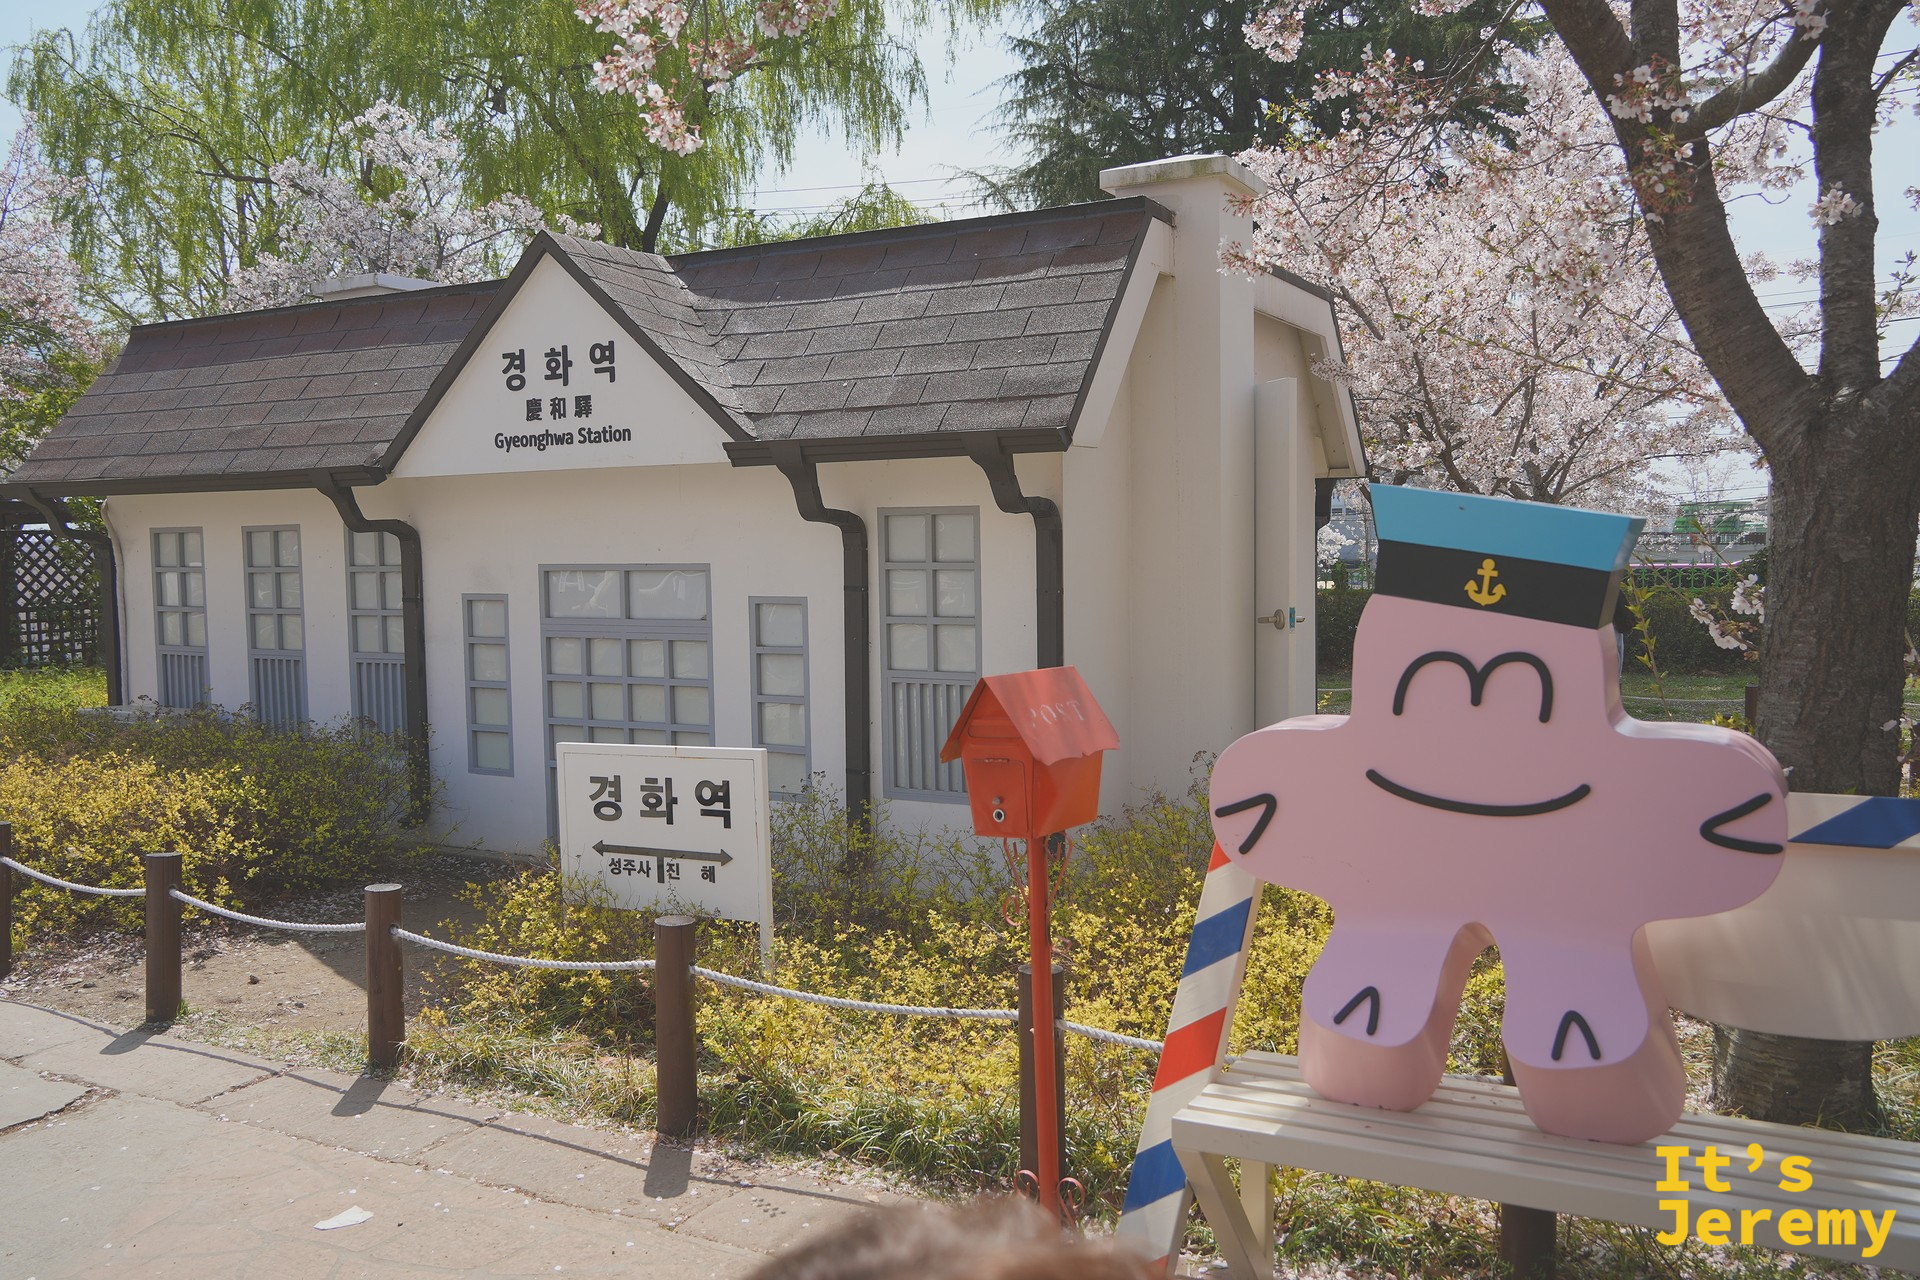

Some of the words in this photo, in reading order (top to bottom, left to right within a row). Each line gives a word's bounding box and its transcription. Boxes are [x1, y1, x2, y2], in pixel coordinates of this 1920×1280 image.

[501, 340, 616, 391] 경화역
[494, 429, 574, 453] Gyeonghwa
[577, 424, 632, 445] Station
[588, 774, 732, 830] 경화역
[608, 857, 652, 878] 성주사
